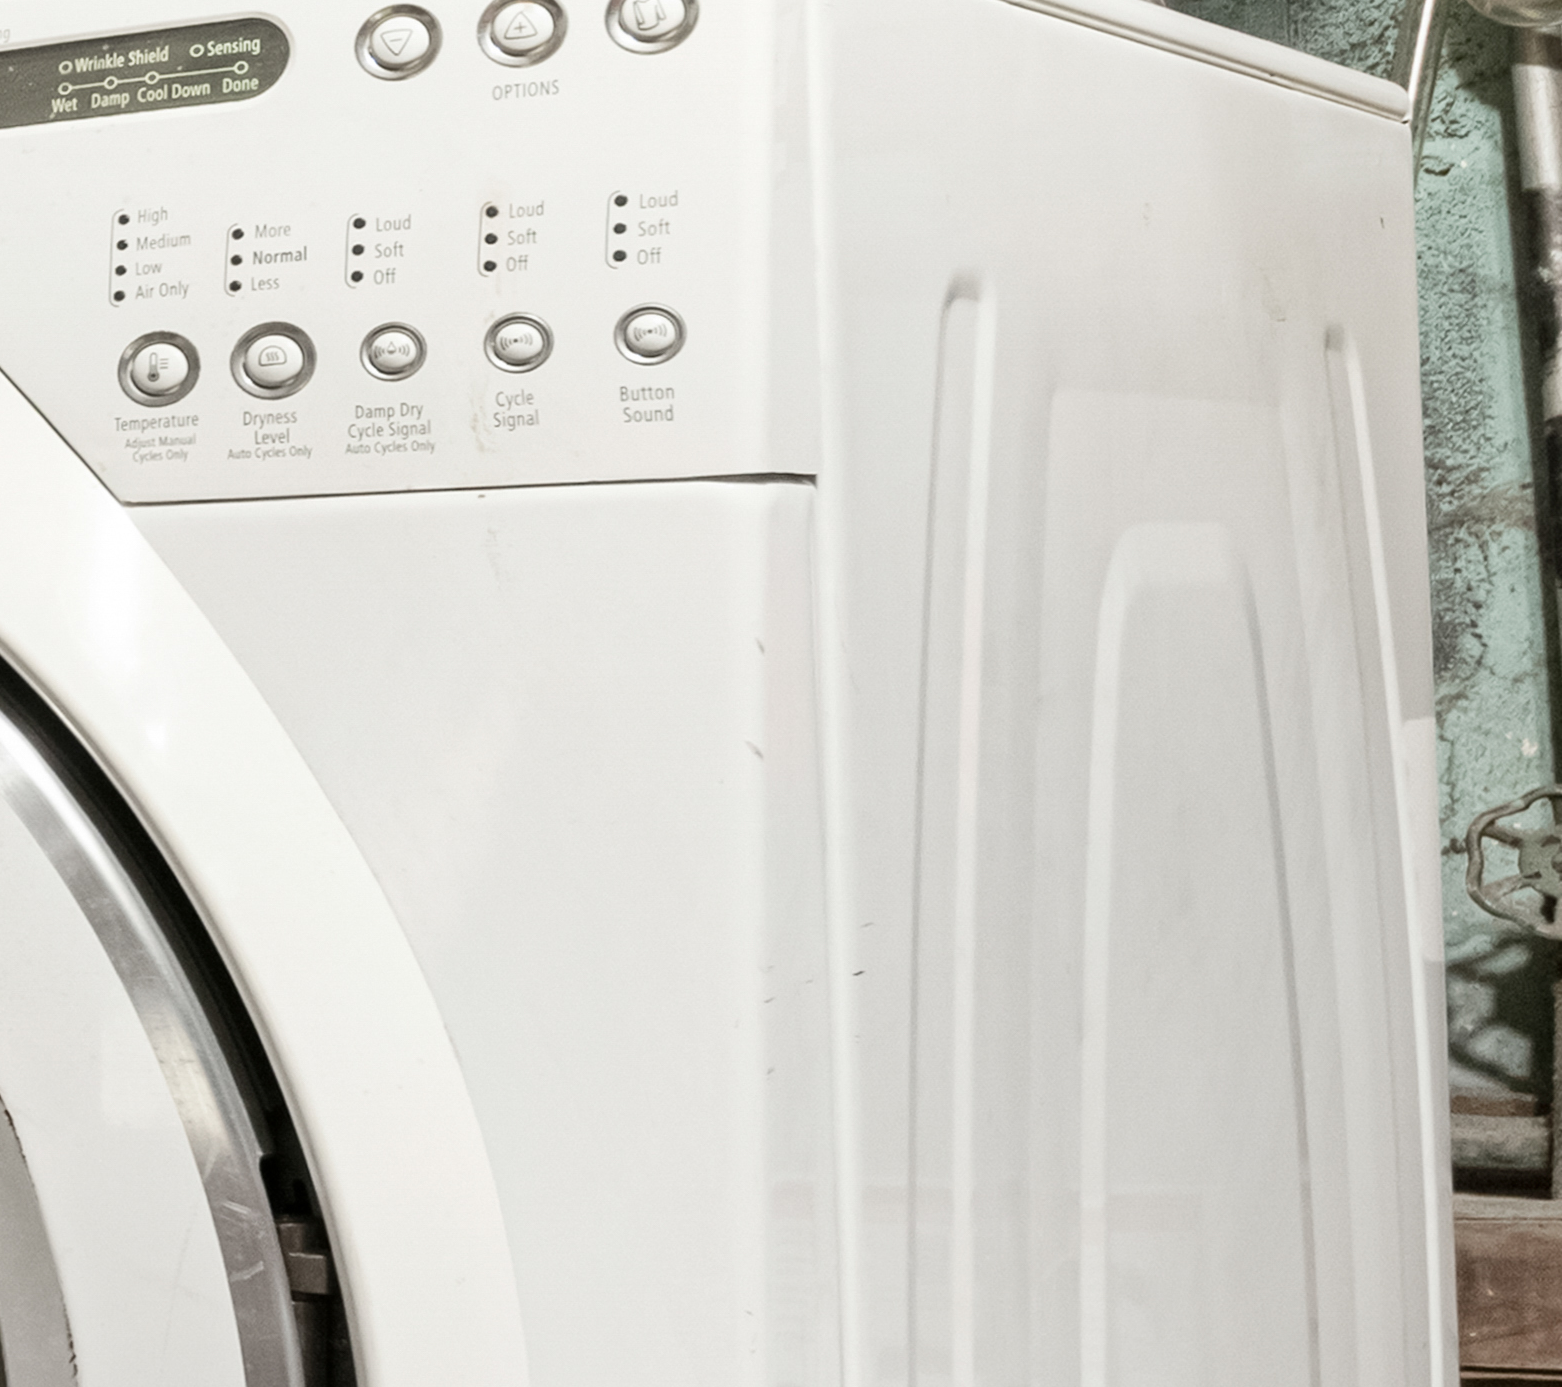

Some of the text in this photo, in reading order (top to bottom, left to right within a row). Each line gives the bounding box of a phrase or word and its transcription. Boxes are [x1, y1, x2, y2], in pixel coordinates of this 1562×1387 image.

[206, 37, 261, 58] Sensing
[74, 45, 169, 74] Wrinkle Shield
[51, 75, 259, 114] Wet Damp Cool Down Done
[491, 79, 560, 101] OPTIONS
[639, 190, 679, 209] Loud
[137, 207, 169, 225] High
[508, 200, 545, 219] Loud
[254, 224, 291, 239] More
[375, 214, 411, 232] Loud
[637, 218, 671, 237] Soft
[135, 233, 192, 251] Medium
[507, 228, 538, 246] Soft
[252, 246, 308, 266] Normal
[374, 241, 405, 259] Soft
[636, 247, 662, 265] Off
[134, 262, 163, 276] Low
[506, 254, 530, 272] Off
[251, 277, 280, 292] Less
[373, 268, 397, 285] Off
[135, 281, 189, 300] Air Only
[495, 389, 535, 411] Cycle
[619, 385, 675, 403] Button
[242, 411, 298, 429] Dryness
[354, 401, 424, 421] Damp Dry
[623, 404, 675, 423] Sound
[114, 414, 199, 433] Temperature
[493, 409, 540, 432] Signal
[254, 428, 290, 445] Level
[347, 419, 432, 442] Cycle Signal
[124, 433, 197, 451] Adjust Manual
[345, 439, 436, 456] Auto Cycles Only
[132, 448, 189, 464] Cycles Only
[227, 445, 313, 461] Auto Cycles Only
